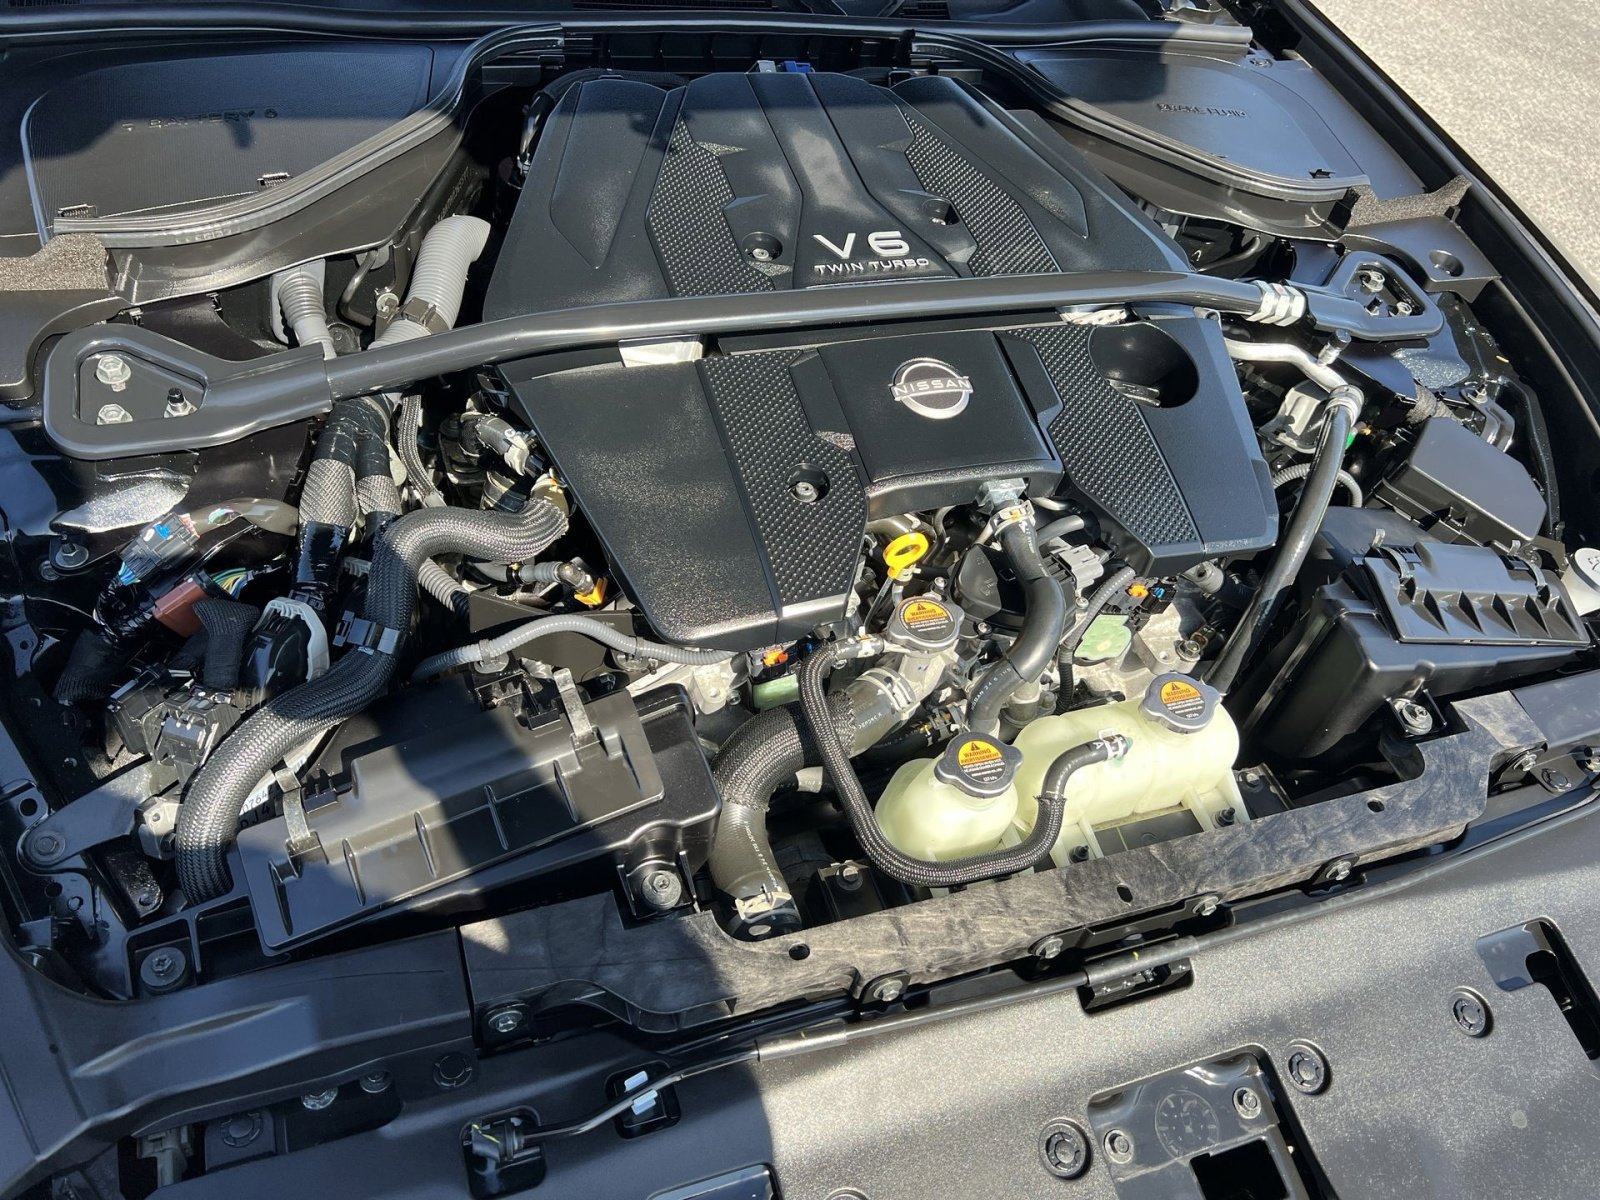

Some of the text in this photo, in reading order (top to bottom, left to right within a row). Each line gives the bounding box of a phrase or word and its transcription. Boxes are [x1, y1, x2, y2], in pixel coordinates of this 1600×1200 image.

[813, 231, 910, 259] V6
[814, 257, 930, 275] TWIN TURBO
[892, 378, 971, 397] NISSAN
[963, 748, 992, 758] WARNING
[1092, 741, 1104, 750] A
